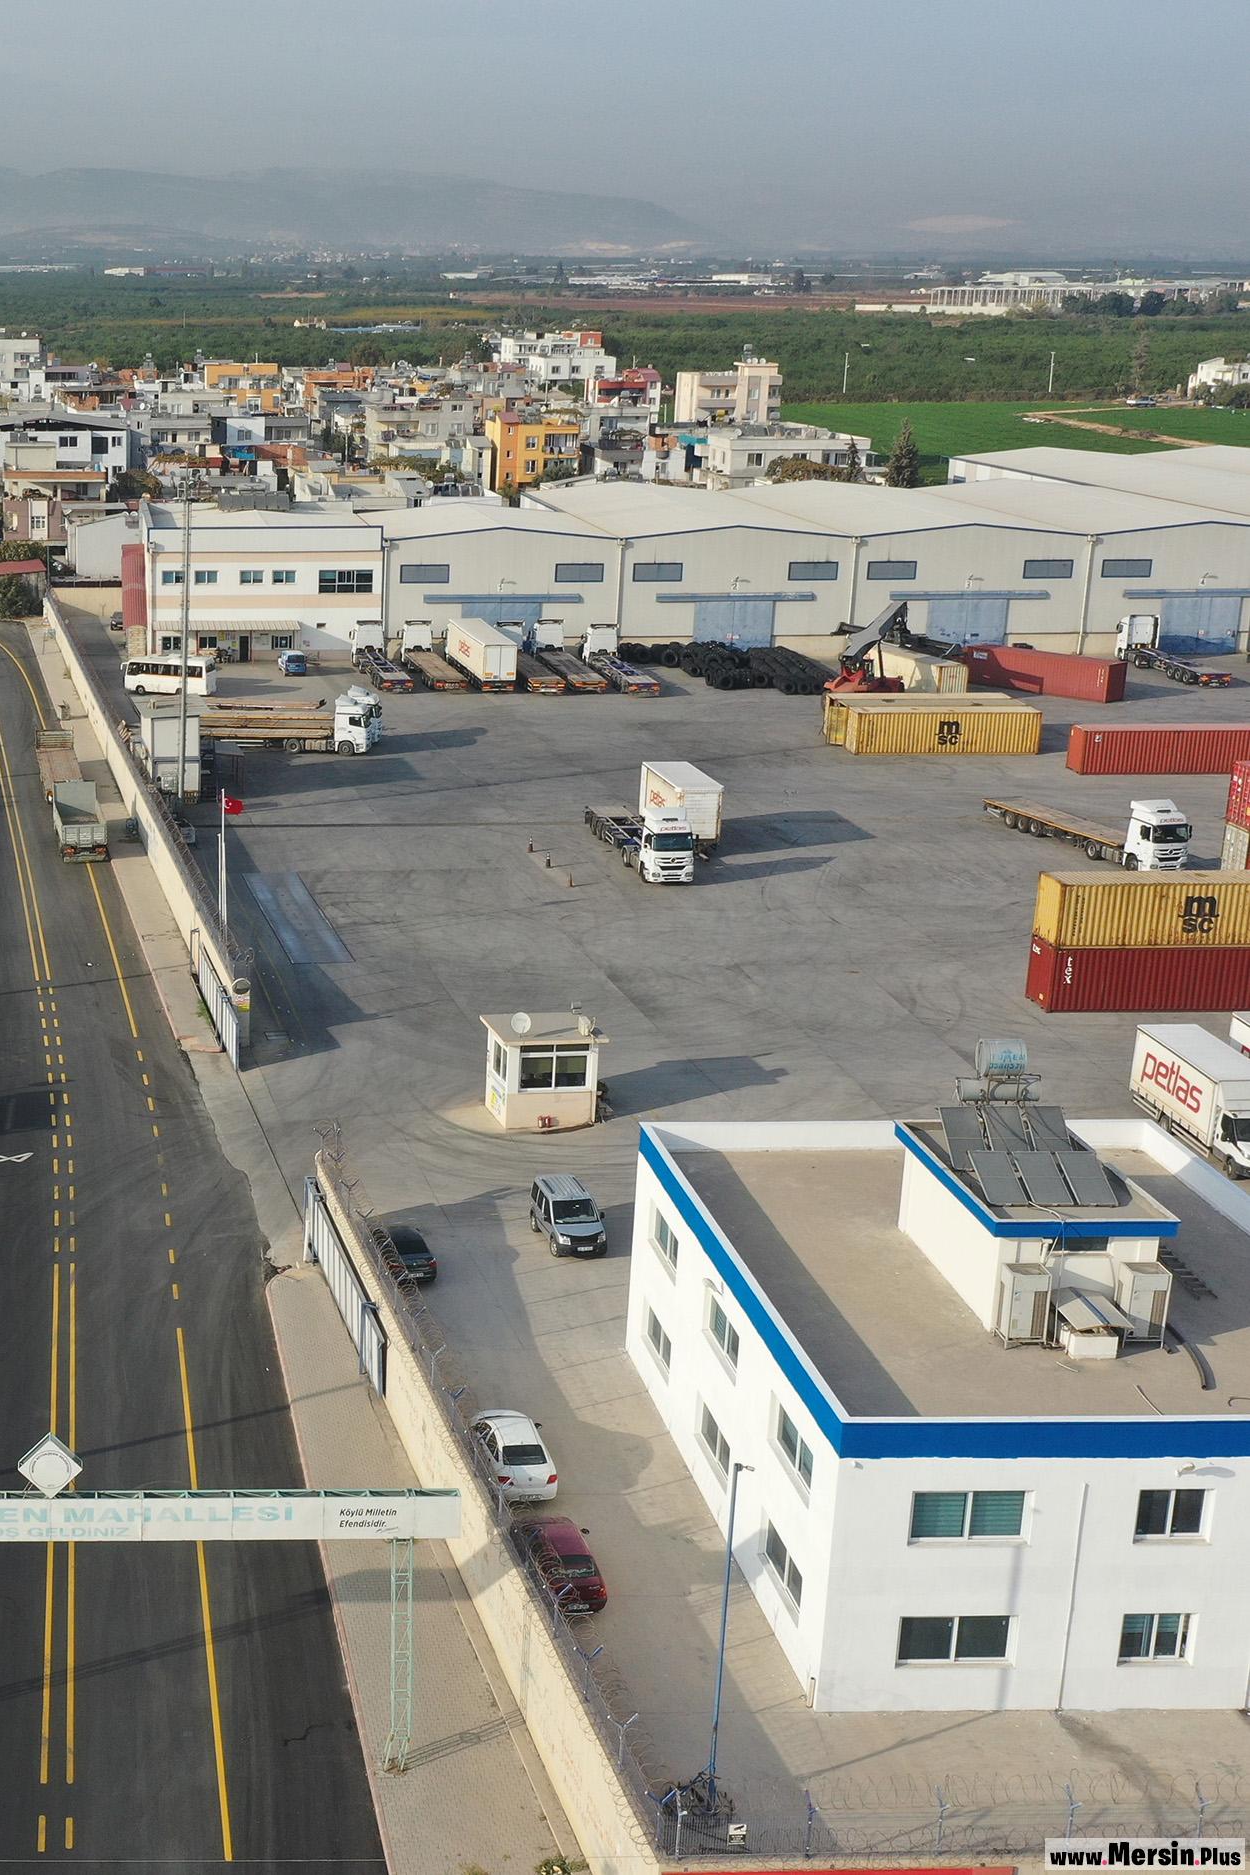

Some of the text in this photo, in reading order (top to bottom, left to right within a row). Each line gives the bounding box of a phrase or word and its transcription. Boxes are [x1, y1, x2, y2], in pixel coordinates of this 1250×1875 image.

[1140, 1051, 1203, 1114] petlas
[62, 1502, 294, 1523] MAHALLESİ
[339, 1508, 398, 1518] Köylü Milletin
[339, 1519, 388, 1528] Efendisidir.
